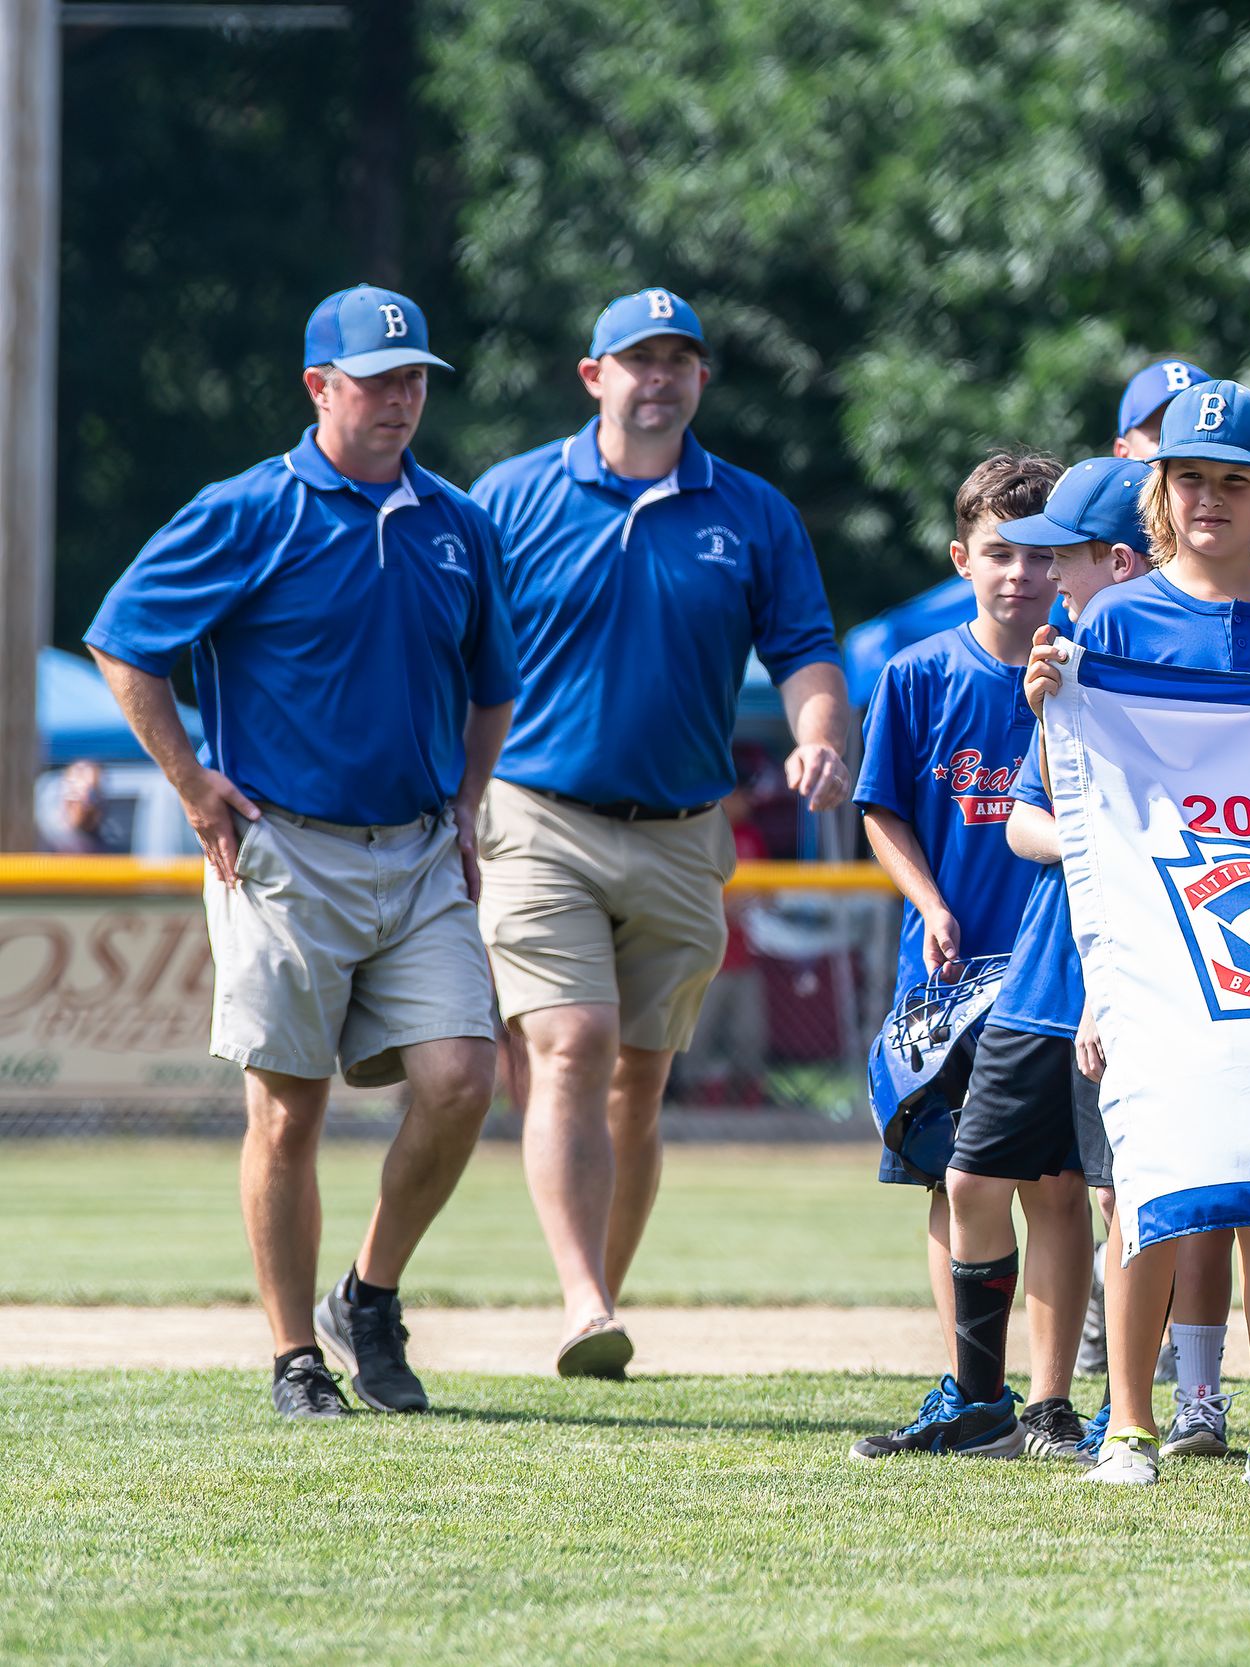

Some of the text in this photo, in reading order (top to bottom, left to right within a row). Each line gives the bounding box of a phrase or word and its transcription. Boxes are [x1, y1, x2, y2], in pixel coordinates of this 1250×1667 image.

[645, 289, 674, 320] B
[377, 303, 408, 339] B
[1163, 361, 1192, 392] B
[1193, 391, 1227, 431] B
[975, 802, 1015, 815] AME
